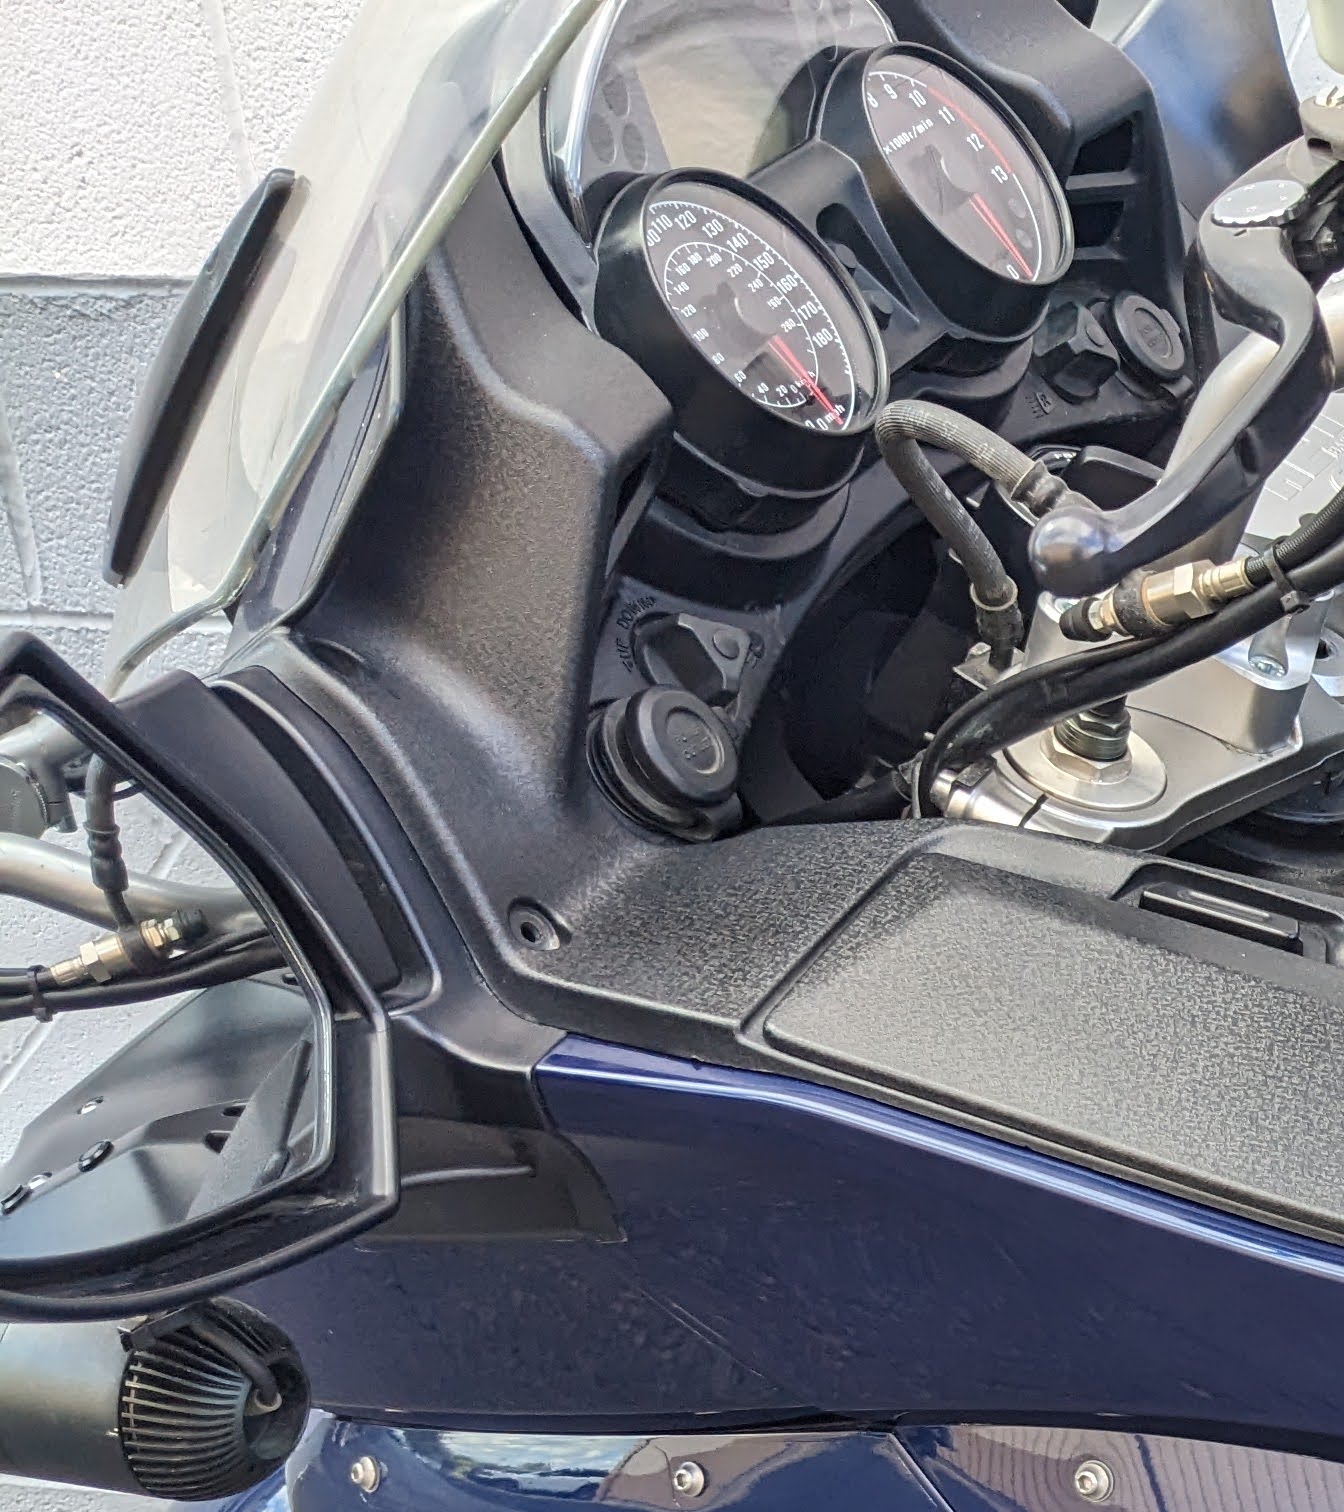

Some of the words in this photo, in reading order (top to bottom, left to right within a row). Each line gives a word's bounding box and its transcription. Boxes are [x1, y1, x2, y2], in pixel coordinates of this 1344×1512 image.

[883, 83, 898, 99] 9
[909, 89, 927, 108] 10
[938, 106, 955, 125] 11
[966, 132, 985, 152] 12
[991, 165, 1009, 184] 13
[651, 214, 673, 234] 110
[674, 210, 697, 230] 120
[702, 219, 724, 239] 130
[726, 232, 749, 252] 140
[726, 263, 743, 278] 220
[753, 251, 775, 271] 150
[1006, 264, 1020, 280] 0
[673, 281, 690, 295] 140
[747, 278, 764, 293] 240
[776, 274, 798, 294] 160
[681, 304, 697, 318] 120
[797, 301, 818, 321] 170
[812, 328, 833, 348] 180
[776, 384, 789, 397] 20
